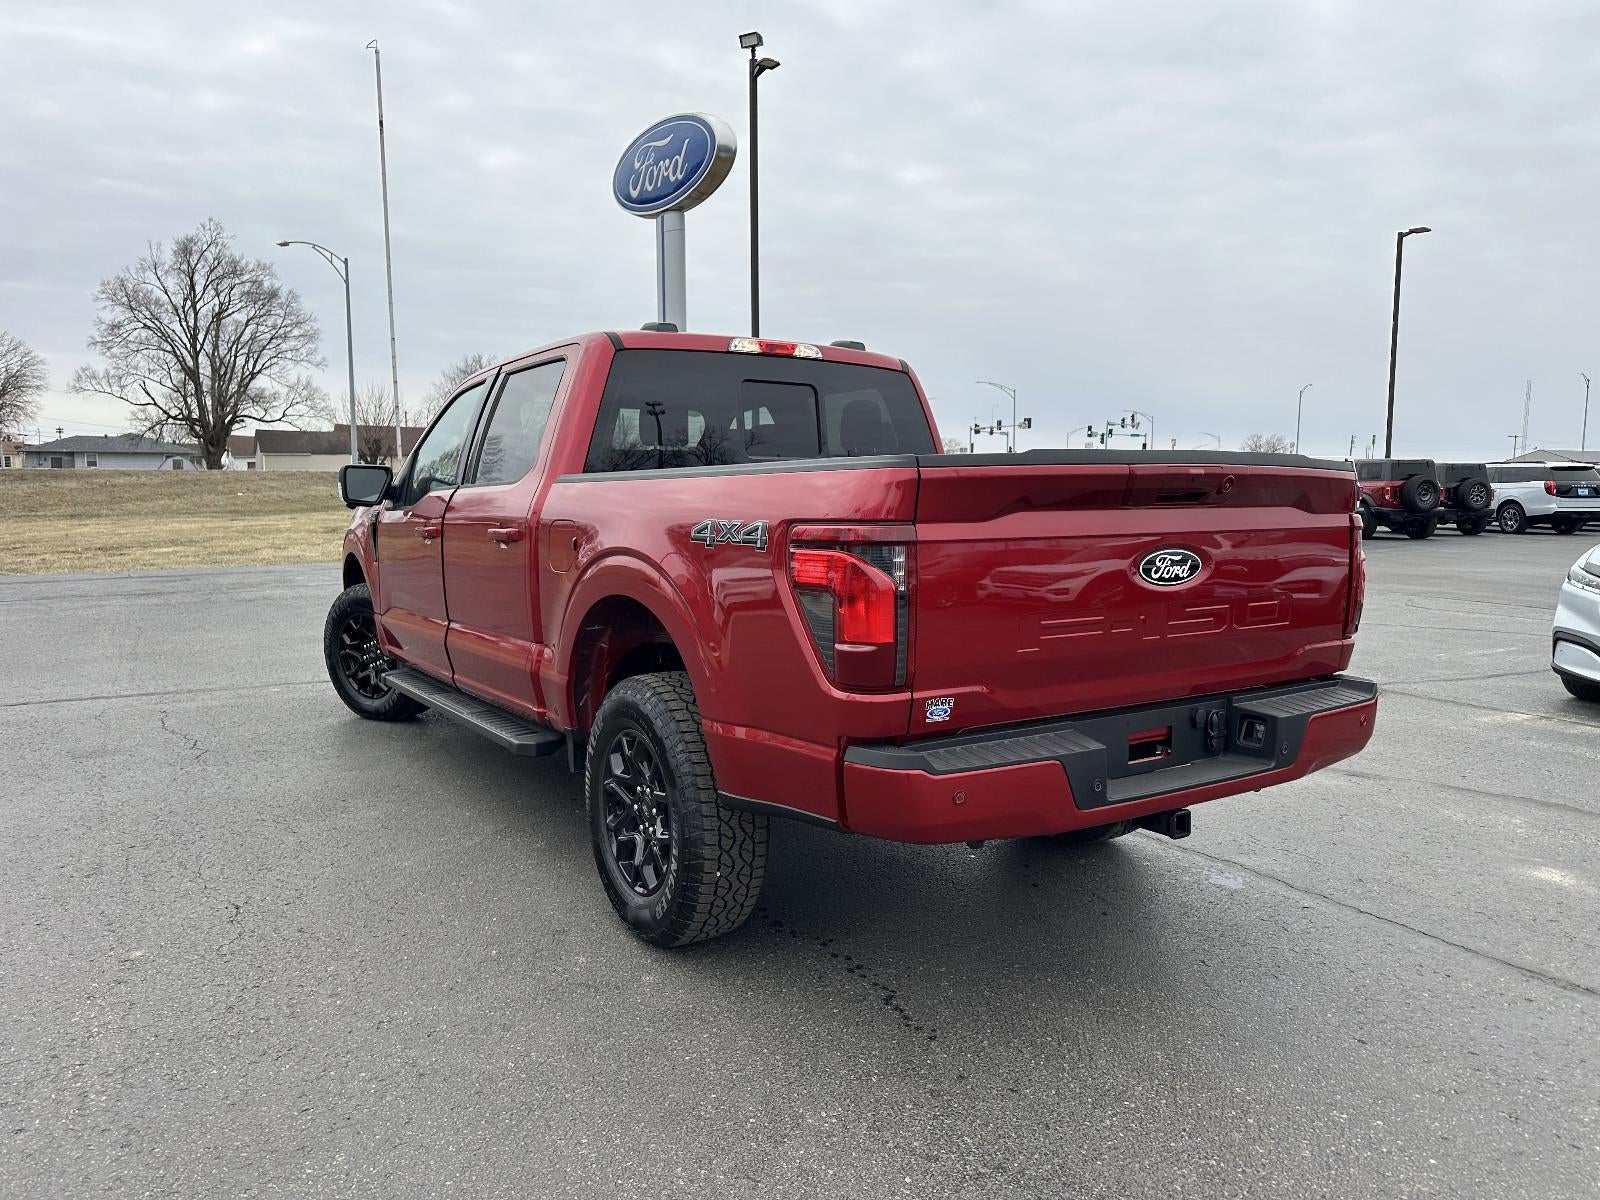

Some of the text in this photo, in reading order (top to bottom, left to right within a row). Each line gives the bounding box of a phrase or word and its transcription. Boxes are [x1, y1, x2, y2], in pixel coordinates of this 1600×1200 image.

[629, 133, 689, 198] Ford
[1151, 554, 1192, 579] Ford
[925, 698, 954, 710] HARE
